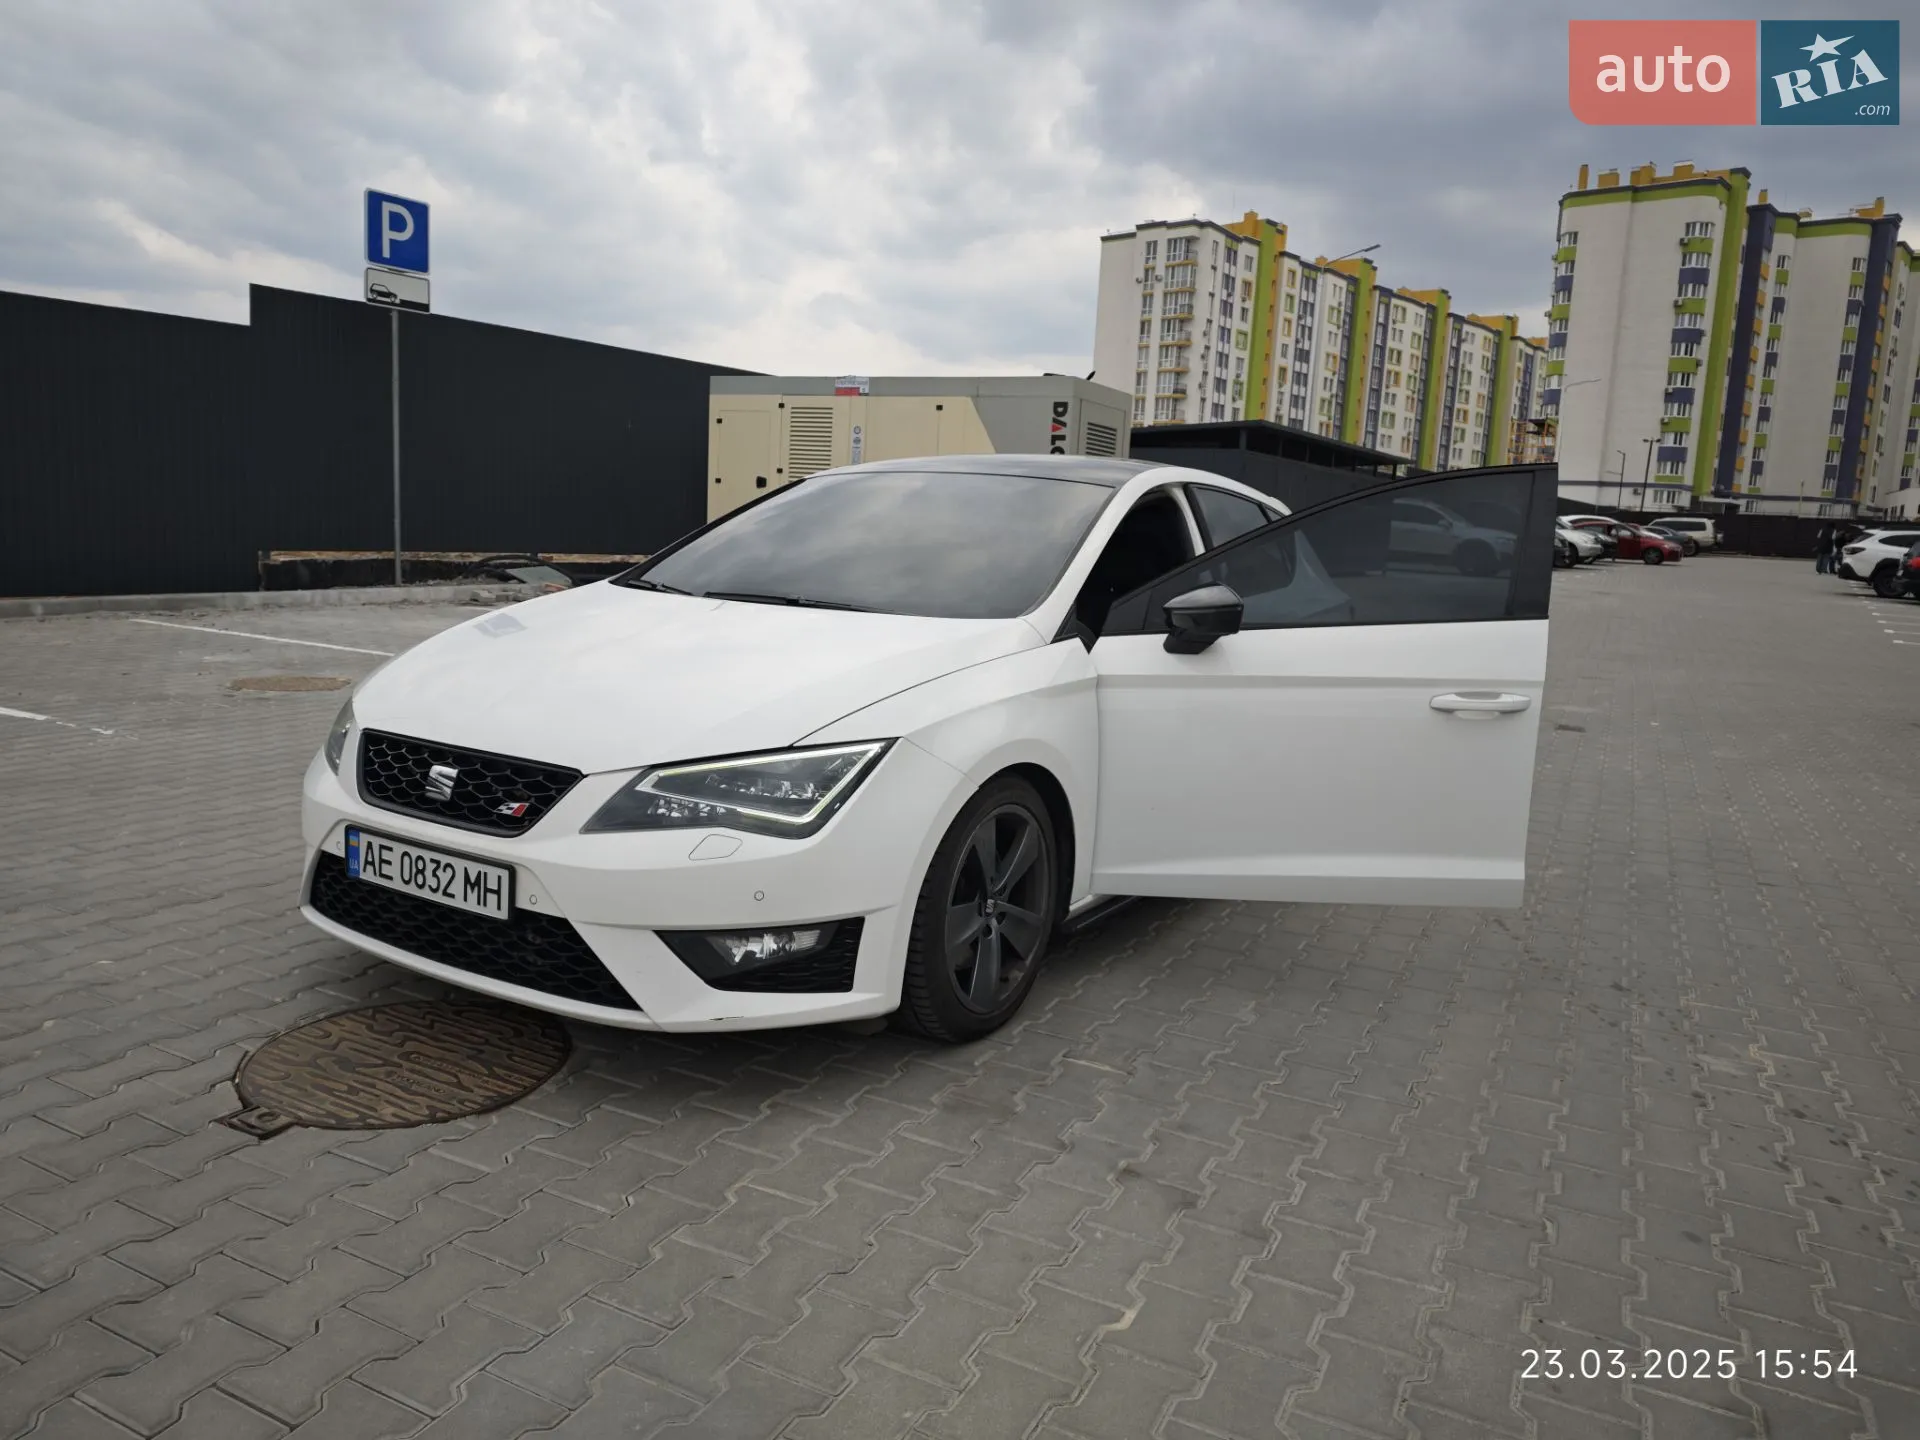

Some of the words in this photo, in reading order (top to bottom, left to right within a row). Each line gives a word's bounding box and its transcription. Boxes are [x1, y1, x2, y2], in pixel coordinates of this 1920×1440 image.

[381, 200, 414, 259] P
[362, 841, 394, 881] AE
[400, 851, 457, 899] 0832
[463, 866, 502, 911] MH
